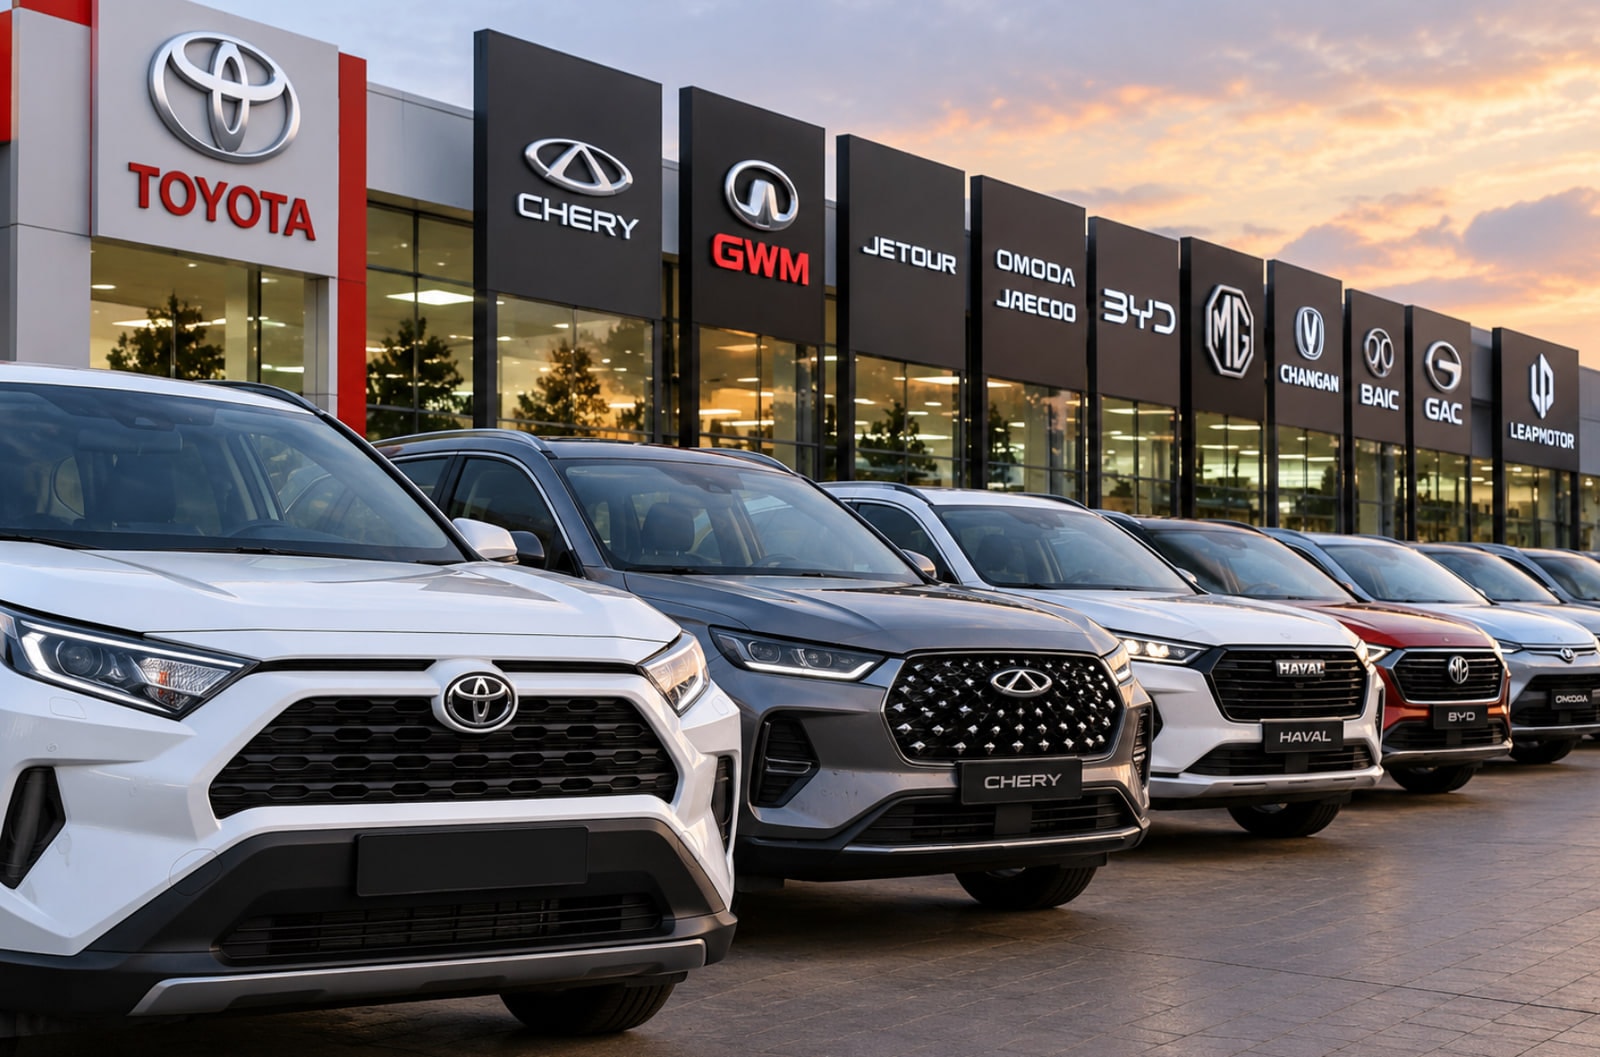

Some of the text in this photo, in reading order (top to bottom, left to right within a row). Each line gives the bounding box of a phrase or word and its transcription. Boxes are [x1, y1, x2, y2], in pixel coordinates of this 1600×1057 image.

[127, 161, 316, 241] TOYOTA
[517, 192, 639, 240] CHERY
[712, 232, 810, 286] GWM
[863, 236, 957, 275] JETOUR
[996, 249, 1076, 286] OMODA
[996, 288, 1077, 323] JAECOO
[1103, 288, 1177, 335] BYD
[1210, 290, 1253, 373] MG
[1280, 364, 1339, 393] CHANGAN
[1361, 383, 1400, 411] BAIC
[1425, 397, 1463, 425] GAC
[1510, 421, 1575, 449] LEAPMOTOR
[1279, 662, 1325, 675] HAVAL
[1447, 711, 1476, 722] BYD
[1279, 730, 1332, 743] HAVAL
[983, 773, 1062, 789] CHERY
